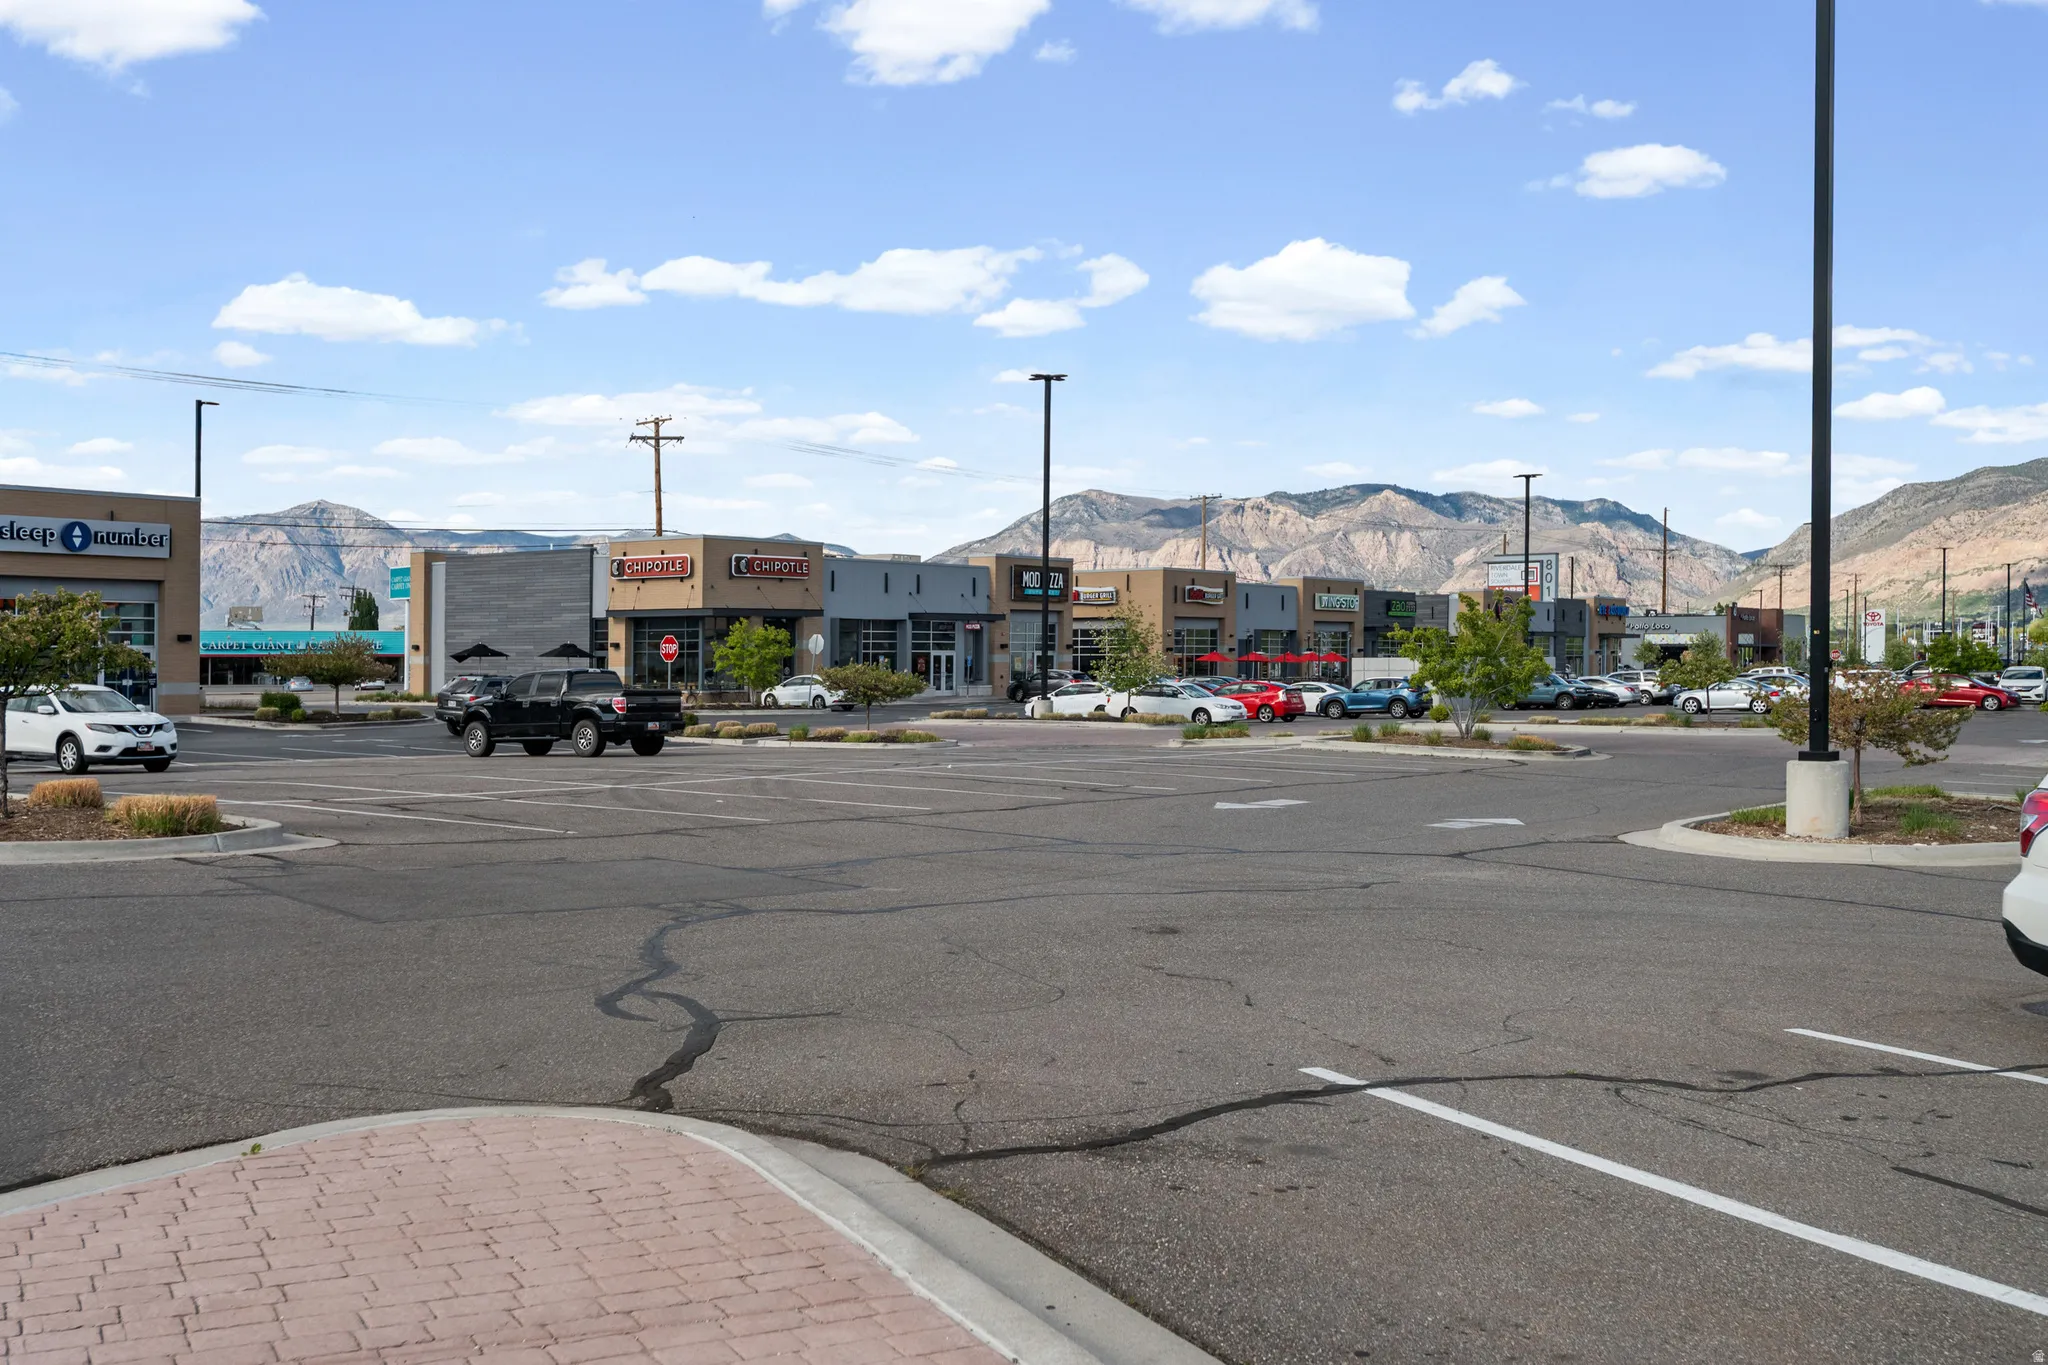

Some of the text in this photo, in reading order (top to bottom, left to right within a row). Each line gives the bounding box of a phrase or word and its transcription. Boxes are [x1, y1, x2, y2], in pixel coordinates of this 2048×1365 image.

[0, 521, 168, 547] sleep number
[625, 559, 684, 574] CHIPOTLE
[754, 560, 809, 574] CHIPOTLE
[1022, 571, 1041, 588] MOD
[200, 641, 247, 650] CARPET
[252, 641, 292, 650] GIANT
[661, 644, 677, 653] STOP
